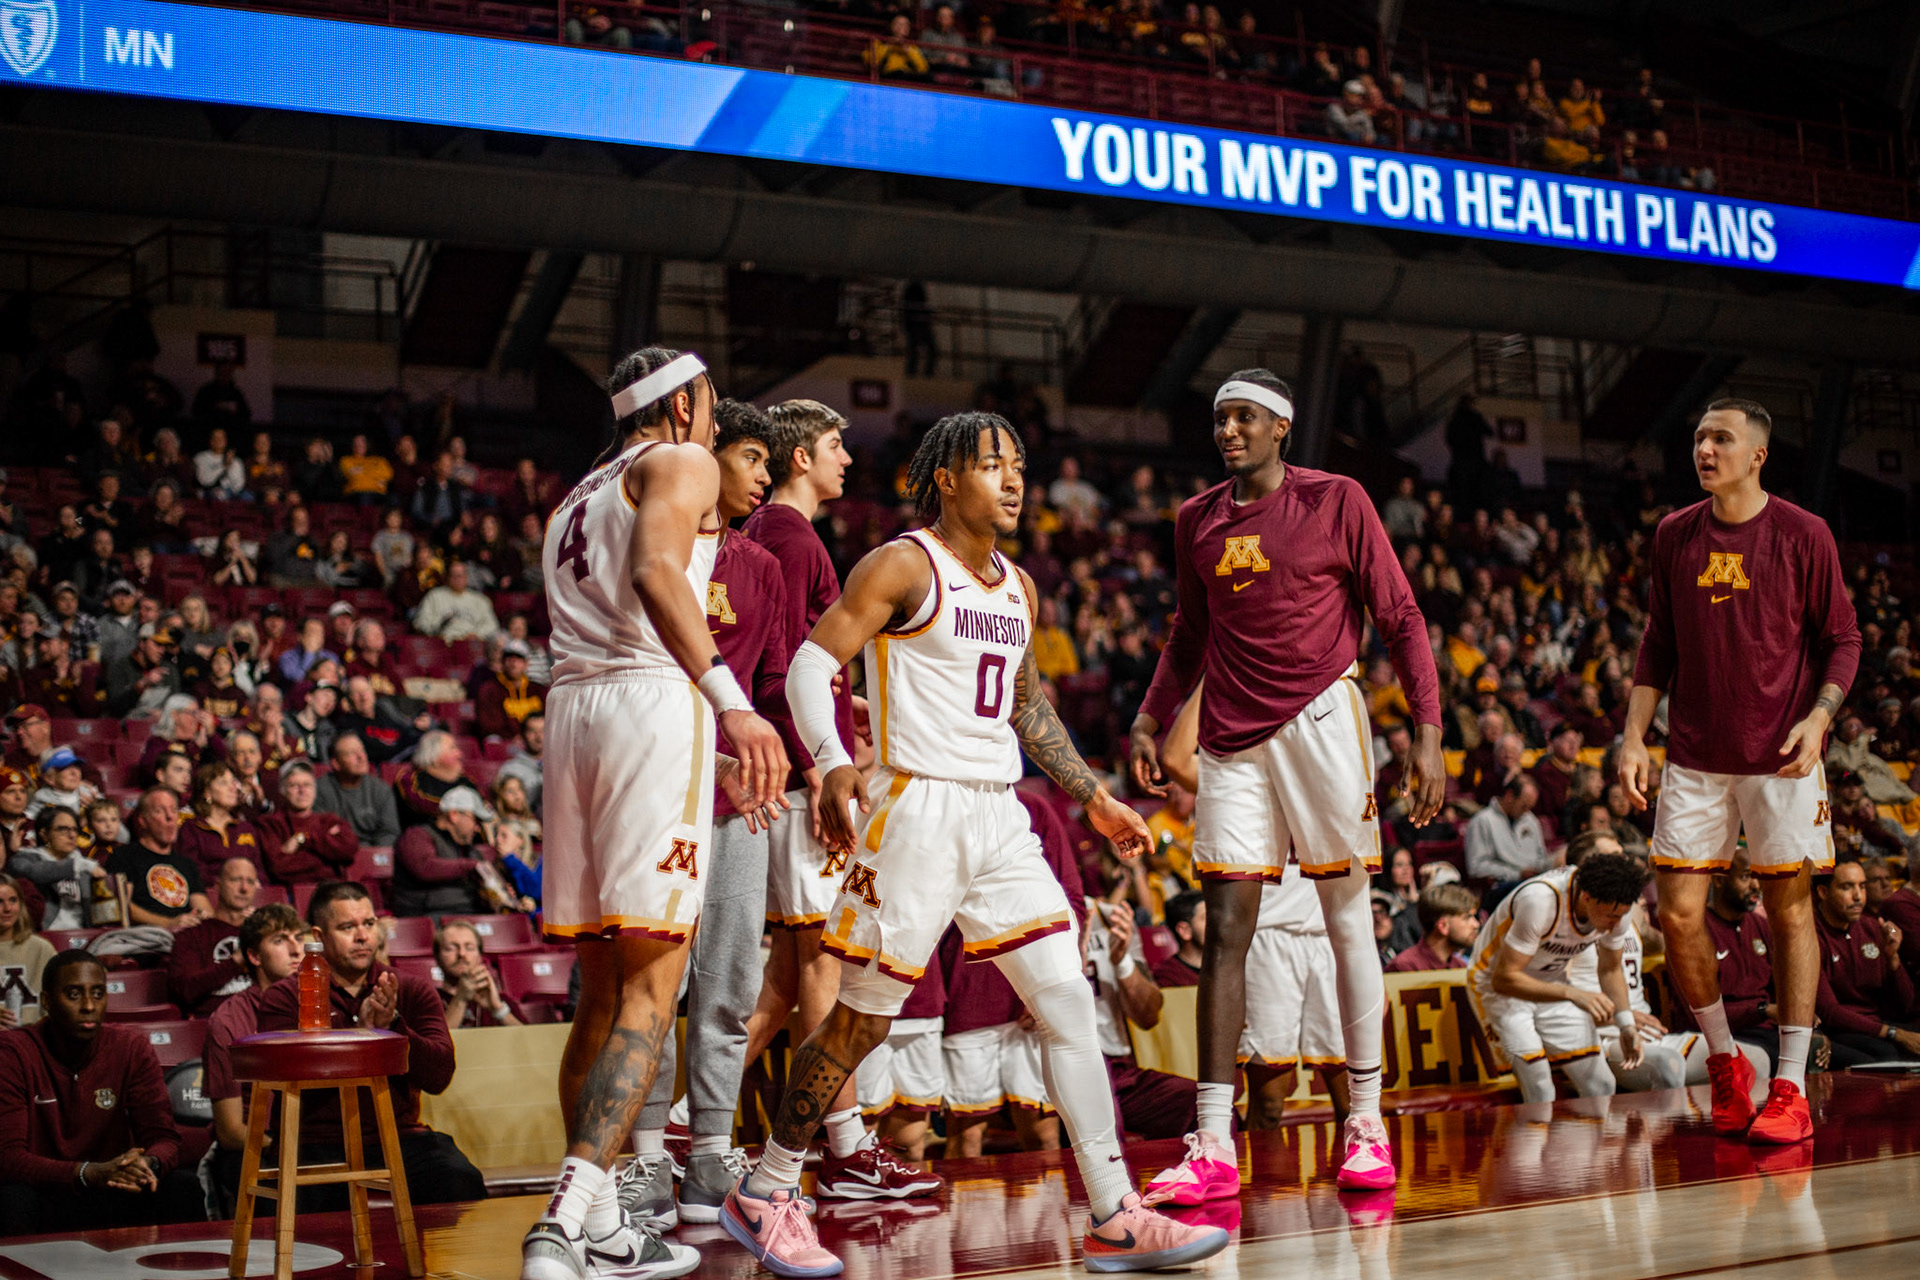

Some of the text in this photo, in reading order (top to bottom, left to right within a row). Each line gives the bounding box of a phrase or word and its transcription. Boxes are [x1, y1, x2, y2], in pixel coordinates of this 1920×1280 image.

[104, 27, 174, 69] MN
[1051, 117, 1777, 263] YOUR MVP FOR HEALTH PLANS
[557, 497, 591, 583] 4
[1215, 534, 1271, 576] M
[1697, 551, 1751, 589] M
[953, 606, 1027, 649] MINNESOTA
[974, 652, 1007, 719] 0
[656, 837, 698, 880] M
[840, 861, 882, 910] M
